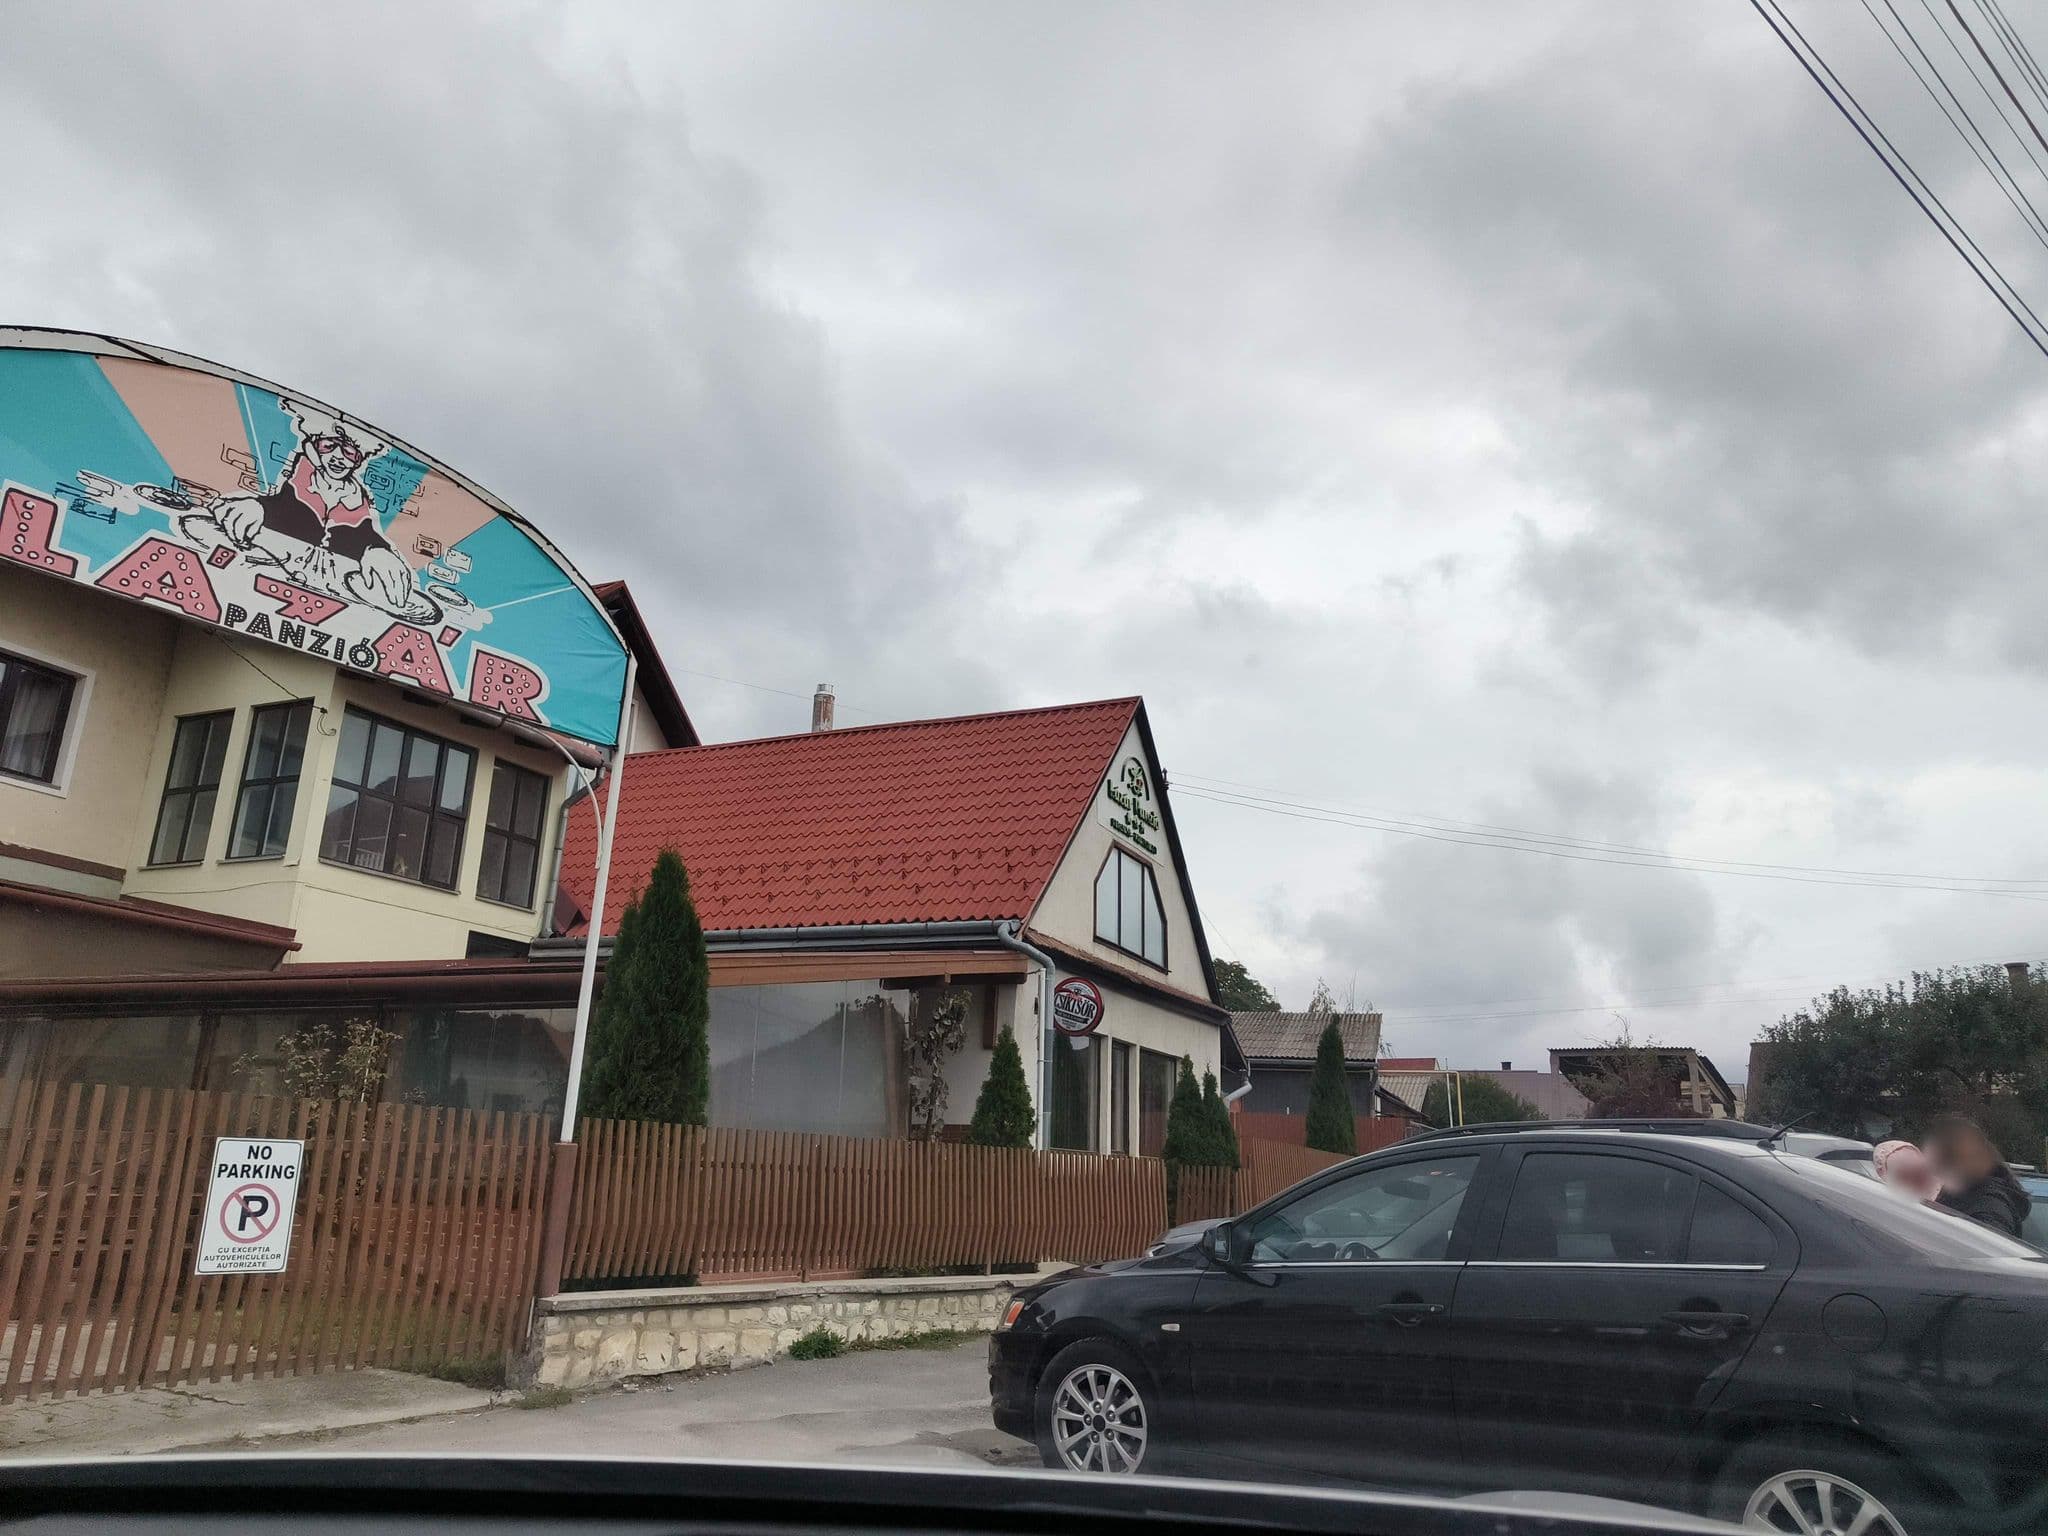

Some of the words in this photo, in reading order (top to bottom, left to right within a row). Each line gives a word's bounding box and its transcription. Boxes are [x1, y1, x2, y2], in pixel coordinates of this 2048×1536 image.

[224, 603, 375, 668] PANZIÓ
[247, 1145, 272, 1160] NO
[217, 1164, 295, 1179] PARKING
[238, 1195, 269, 1231] P
